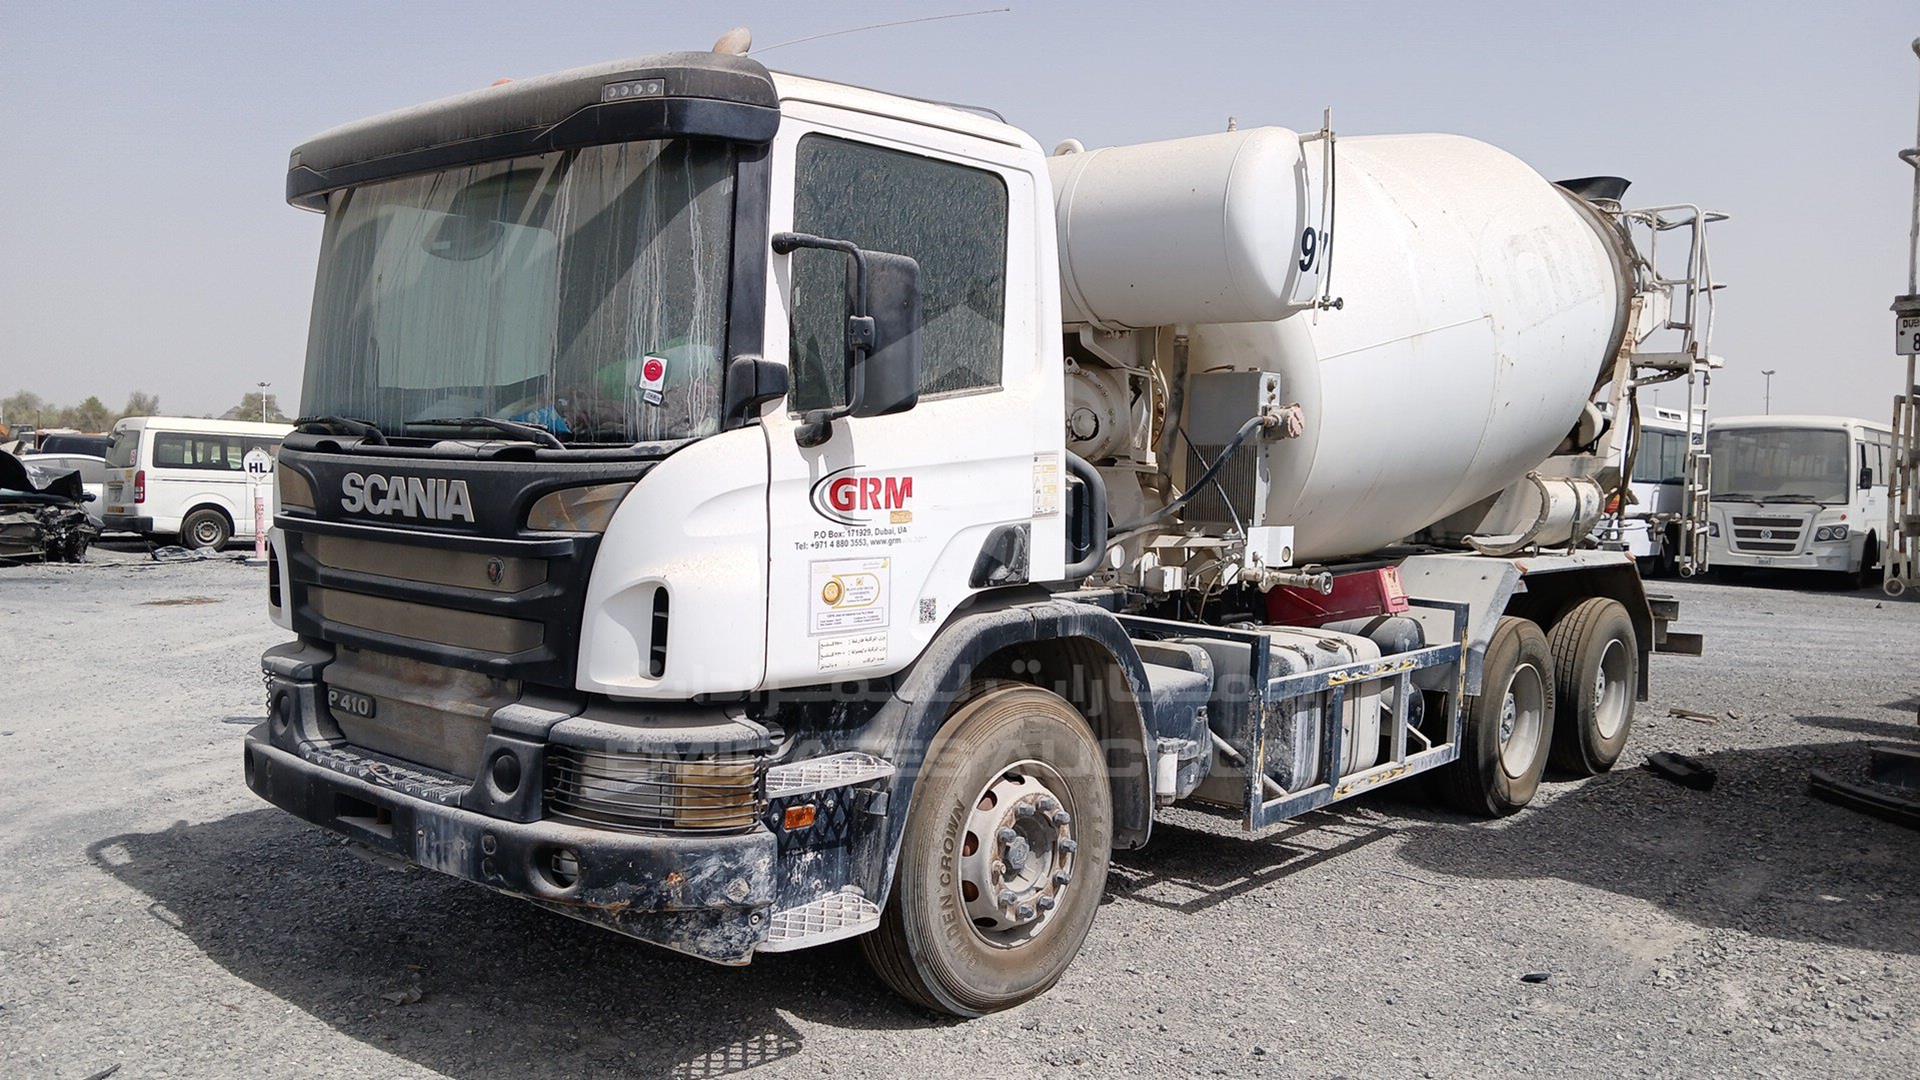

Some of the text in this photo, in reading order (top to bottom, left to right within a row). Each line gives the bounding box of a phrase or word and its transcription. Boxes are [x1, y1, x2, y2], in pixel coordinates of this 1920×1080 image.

[249, 462, 267, 473] HL
[341, 472, 475, 523] SCANIA
[829, 476, 913, 512] GRM
[795, 541, 809, 550] Tel:
[810, 540, 828, 550] +971
[828, 530, 846, 539] Box:
[328, 690, 369, 715] P 410
[940, 799, 966, 886] CROWN
